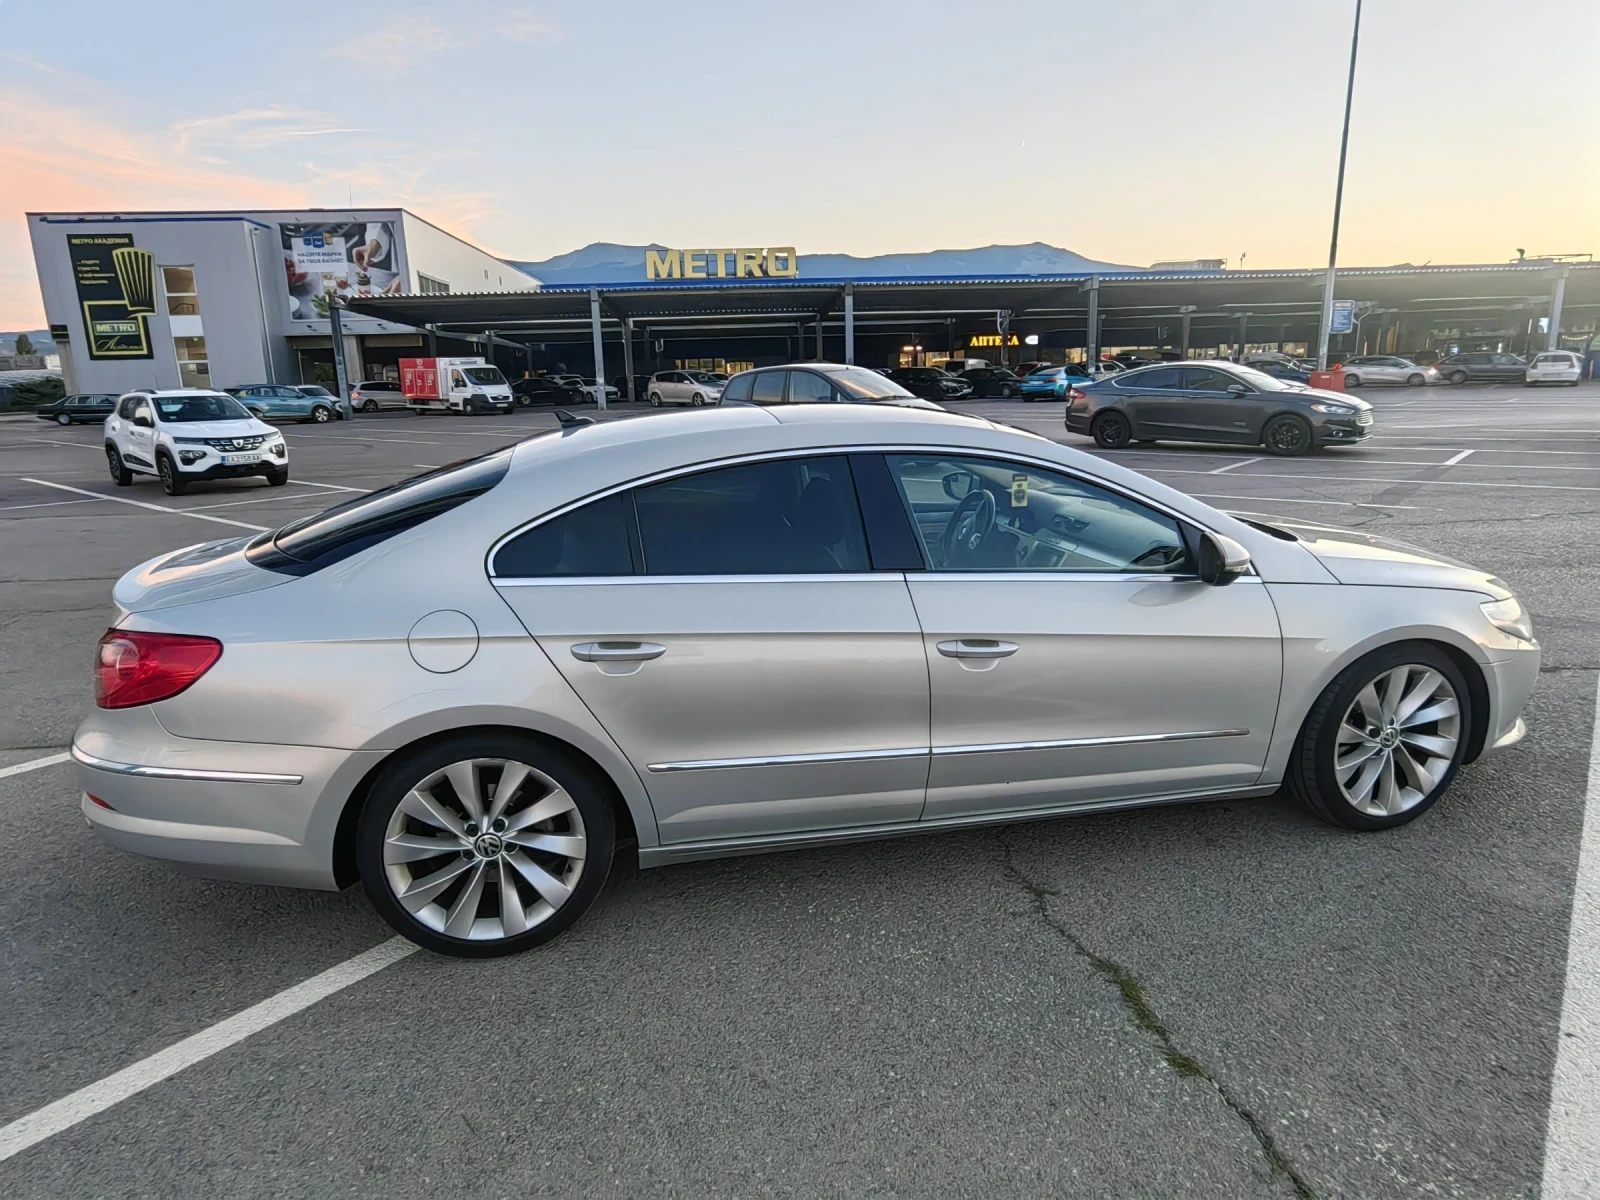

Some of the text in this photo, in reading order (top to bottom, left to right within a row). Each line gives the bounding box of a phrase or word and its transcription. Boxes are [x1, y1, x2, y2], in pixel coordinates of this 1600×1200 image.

[645, 247, 797, 279] METRO
[95, 323, 136, 332] METRO
[969, 335, 1019, 347] АПТЕА
